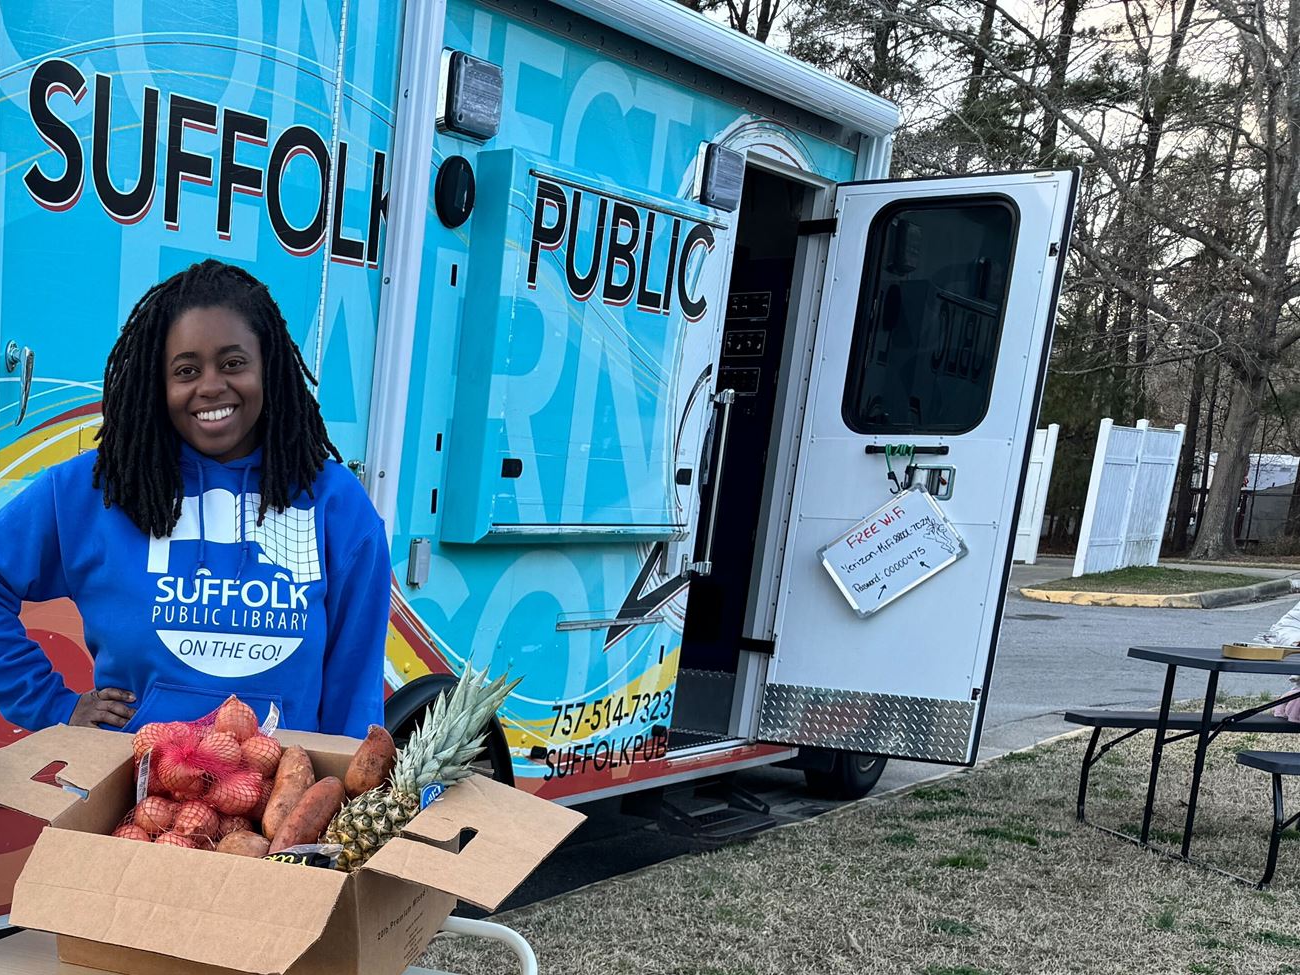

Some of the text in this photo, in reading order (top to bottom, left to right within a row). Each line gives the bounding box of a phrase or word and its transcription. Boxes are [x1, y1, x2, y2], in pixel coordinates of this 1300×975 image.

[526, 179, 716, 323] PUBLIC
[846, 522, 880, 550] FREE
[155, 575, 310, 609] SUFFOLK
[151, 605, 308, 631] PUBLIC LIBRARY
[178, 638, 283, 662] ON THE GO!
[550, 690, 673, 738] 757-514-7323
[543, 733, 668, 782] SUFFOLKPUB
